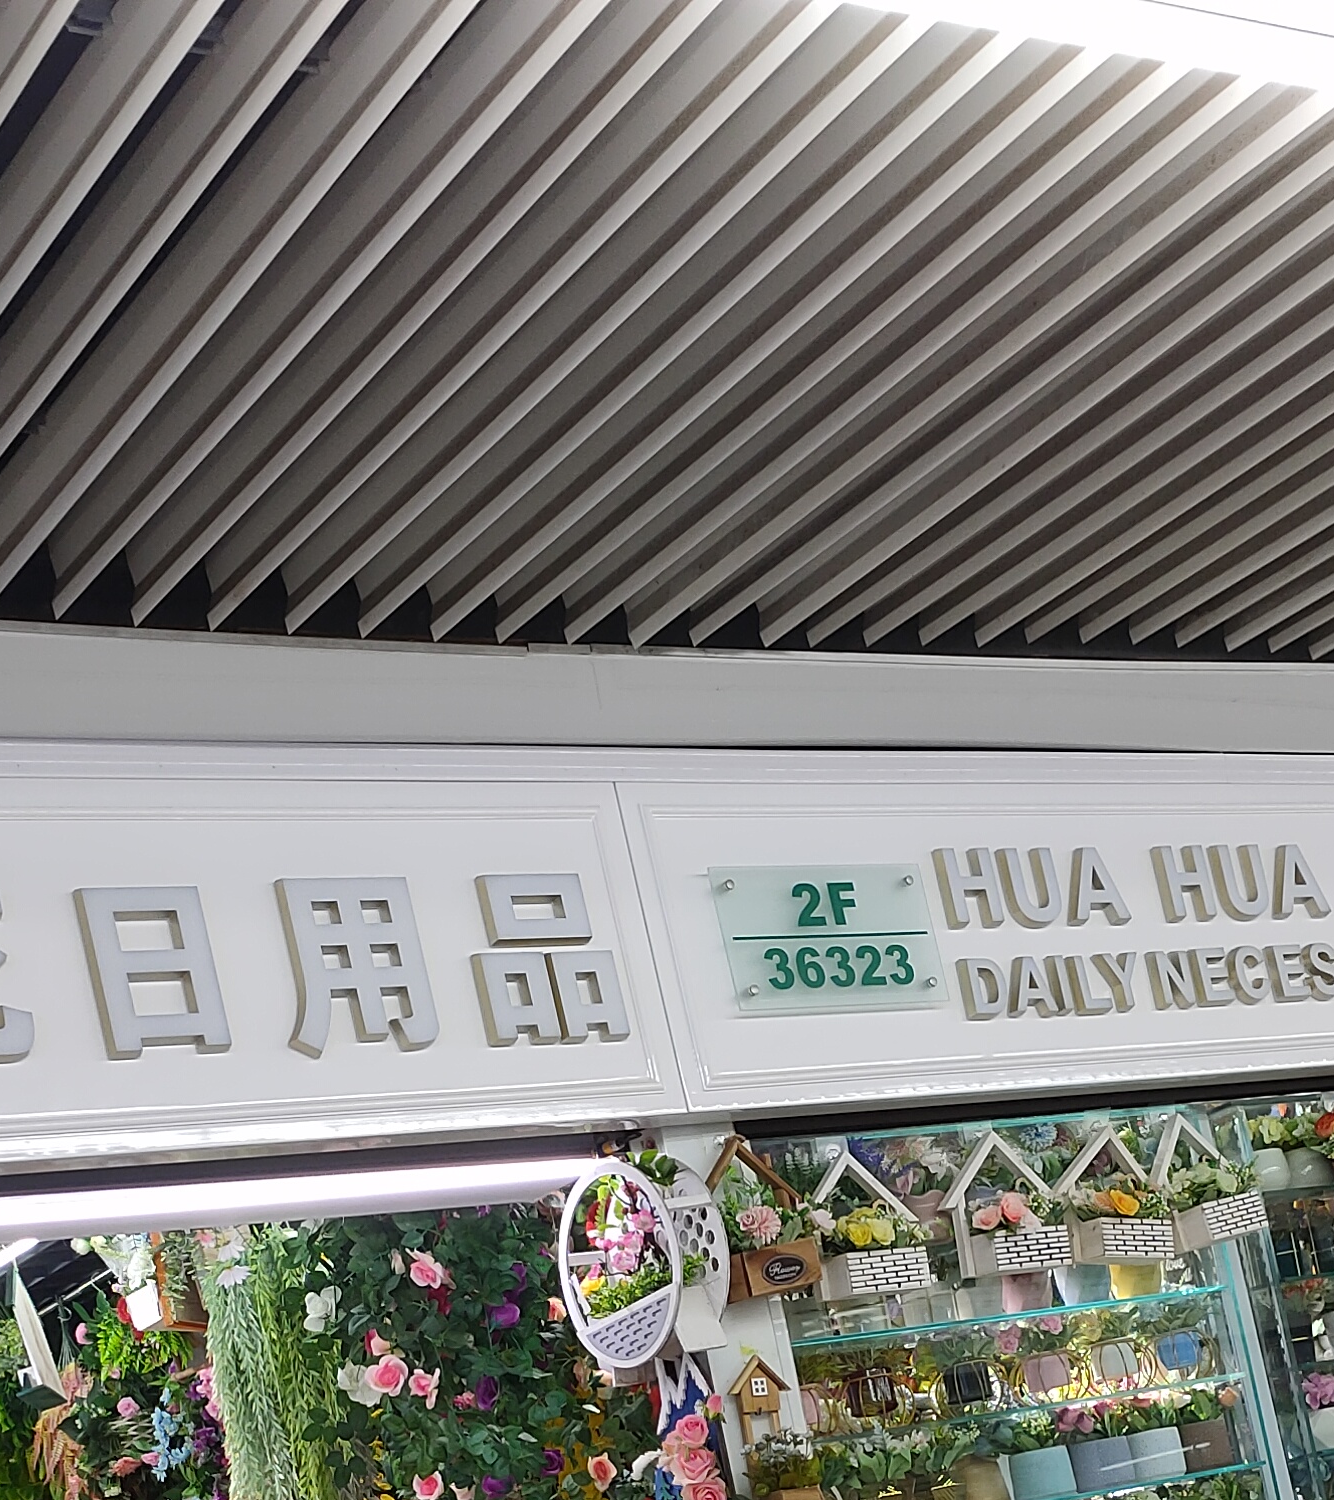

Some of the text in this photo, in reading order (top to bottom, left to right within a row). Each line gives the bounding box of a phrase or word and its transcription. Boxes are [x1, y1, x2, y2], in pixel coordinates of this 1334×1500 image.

[791, 881, 858, 929] 2F
[931, 843, 1332, 930] HUA HUA
[763, 942, 916, 990] 36323
[955, 951, 1137, 1022] DAILY
